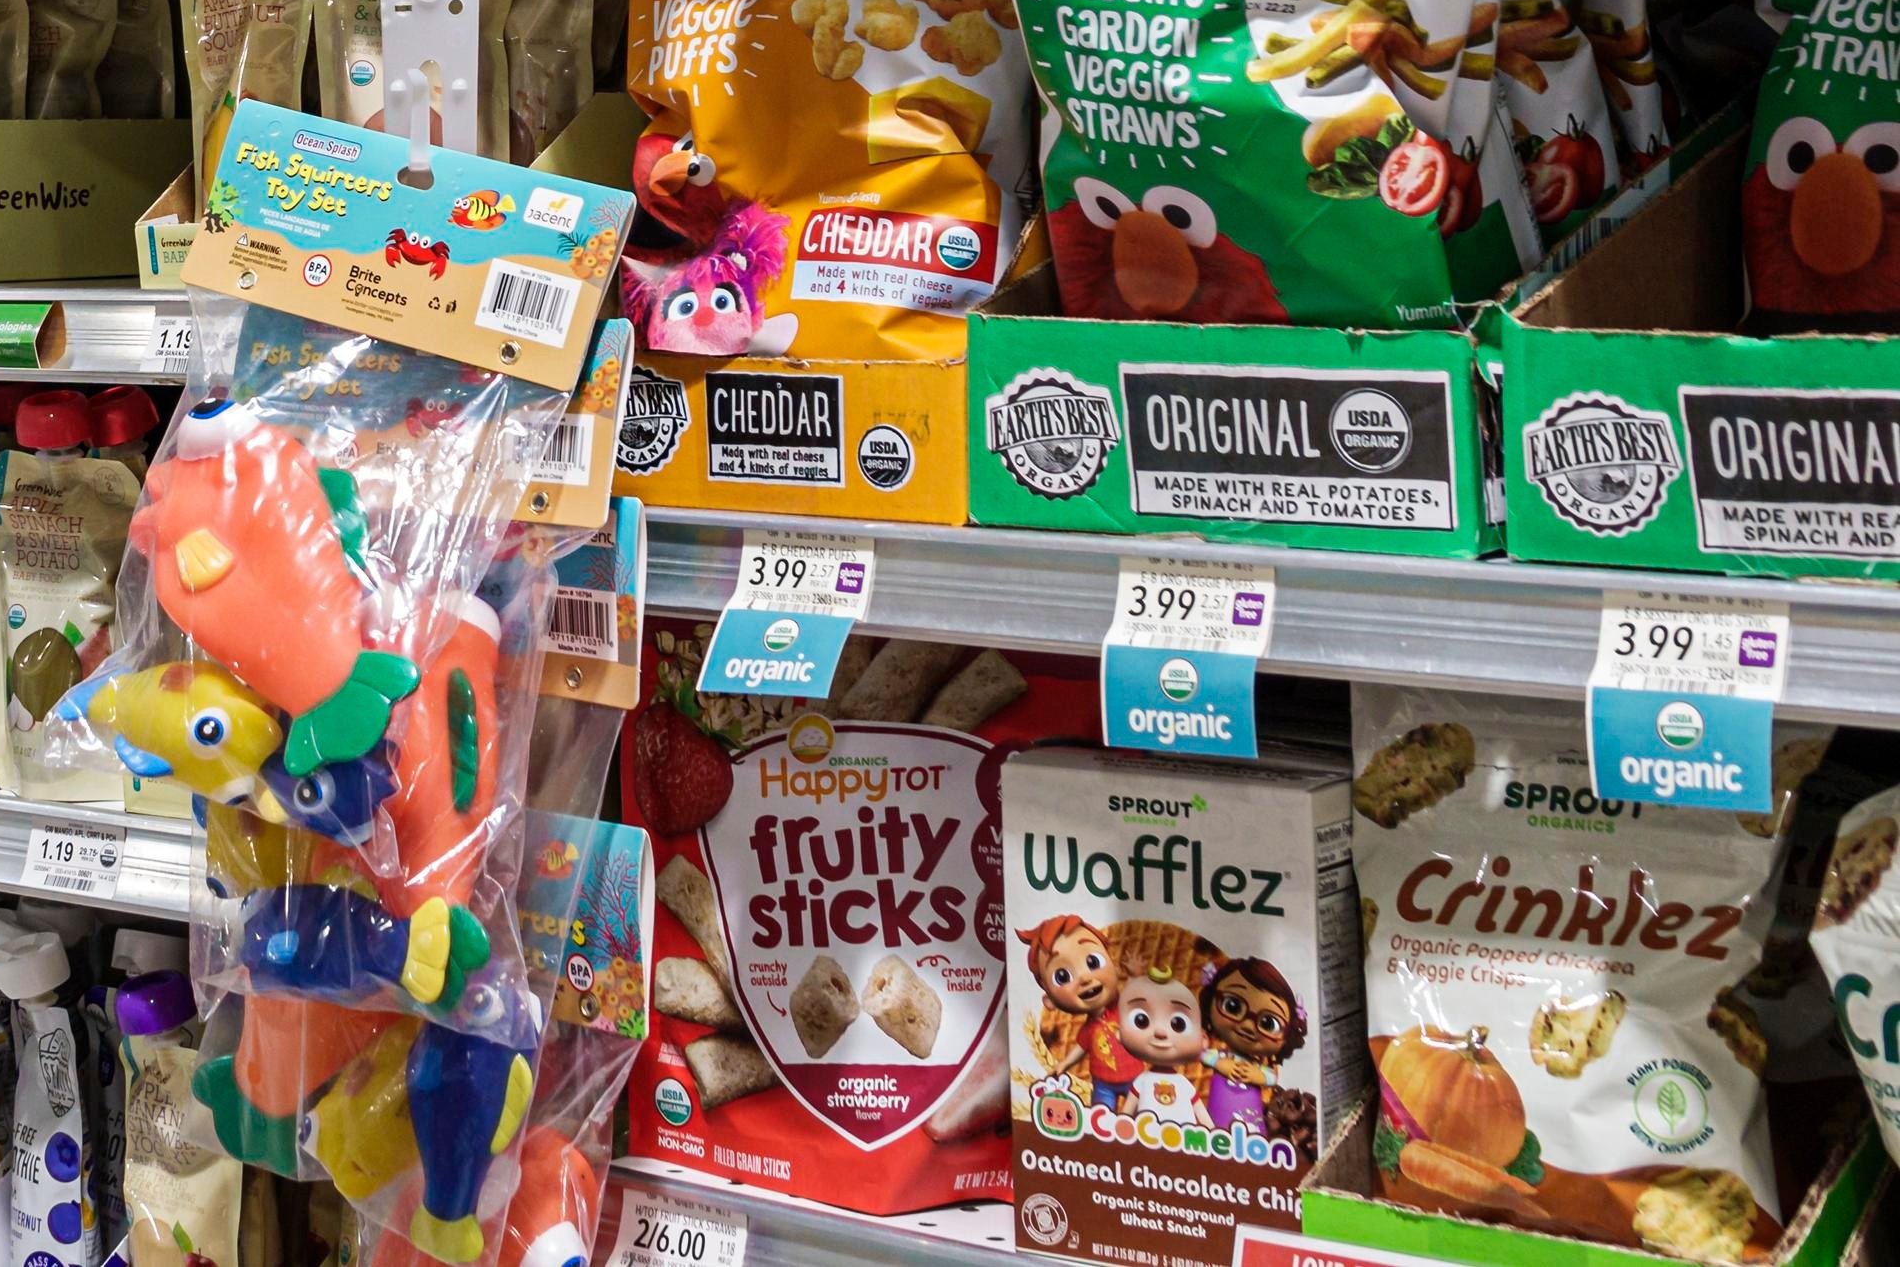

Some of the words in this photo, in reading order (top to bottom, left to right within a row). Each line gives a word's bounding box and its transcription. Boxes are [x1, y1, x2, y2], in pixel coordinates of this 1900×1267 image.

[1066, 100, 1200, 149] STRAWS
[295, 134, 324, 151] Ocean
[326, 140, 358, 158] Splash
[236, 142, 280, 172] Fish
[284, 154, 393, 202] Squirters
[265, 183, 305, 213] Toy
[308, 192, 348, 217] Set
[308, 261, 328, 275] BPA
[349, 265, 382, 285] Brite
[345, 280, 408, 307] Concepts
[713, 387, 833, 437] CHEDDAR
[1066, 398, 1110, 437] BEST
[1348, 410, 1392, 428] USDA
[1146, 395, 1321, 458] ORIGINAL
[1344, 432, 1399, 449] ORGANIC
[1155, 478, 1207, 493] MADE
[1216, 480, 1266, 495] WITH
[1272, 482, 1320, 498] REAL
[1328, 484, 1440, 507] POTATOES,
[1172, 494, 1251, 512] SPINACH
[1259, 499, 1298, 515] AND
[1307, 502, 1415, 521] TOMATOES
[749, 559, 807, 589] 3.99
[1128, 588, 1196, 620] 3.99
[1613, 622, 1694, 661] 3.99
[829, 756, 888, 767] ORGANICS
[760, 757, 947, 804] HappyTOT
[1108, 795, 1193, 819] SPROUT
[1527, 814, 1616, 834] ORGANICS
[40, 838, 74, 863] 1.19
[749, 806, 961, 884] fruity
[1025, 833, 1286, 917] Wafflez
[749, 879, 966, 948] sticks
[1396, 856, 1745, 961] Crinklez
[749, 961, 788, 976] crunchy
[1465, 942, 1542, 968] Popped
[1545, 952, 1635, 976] Chickpea
[750, 975, 788, 988] outside
[941, 966, 986, 981] creamy
[947, 978, 983, 993] inside
[827, 1091, 910, 1112] strawberry
[855, 1109, 882, 1121] flavor
[658, 1136, 705, 1158] NON-GMO
[1021, 1149, 1124, 1186] Oatmeal
[1130, 1166, 1251, 1206] Chocolate
[1121, 1212, 1164, 1231] Wheat
[1167, 1222, 1207, 1239] Snack
[1148, 1199, 1235, 1227] Stoneground
